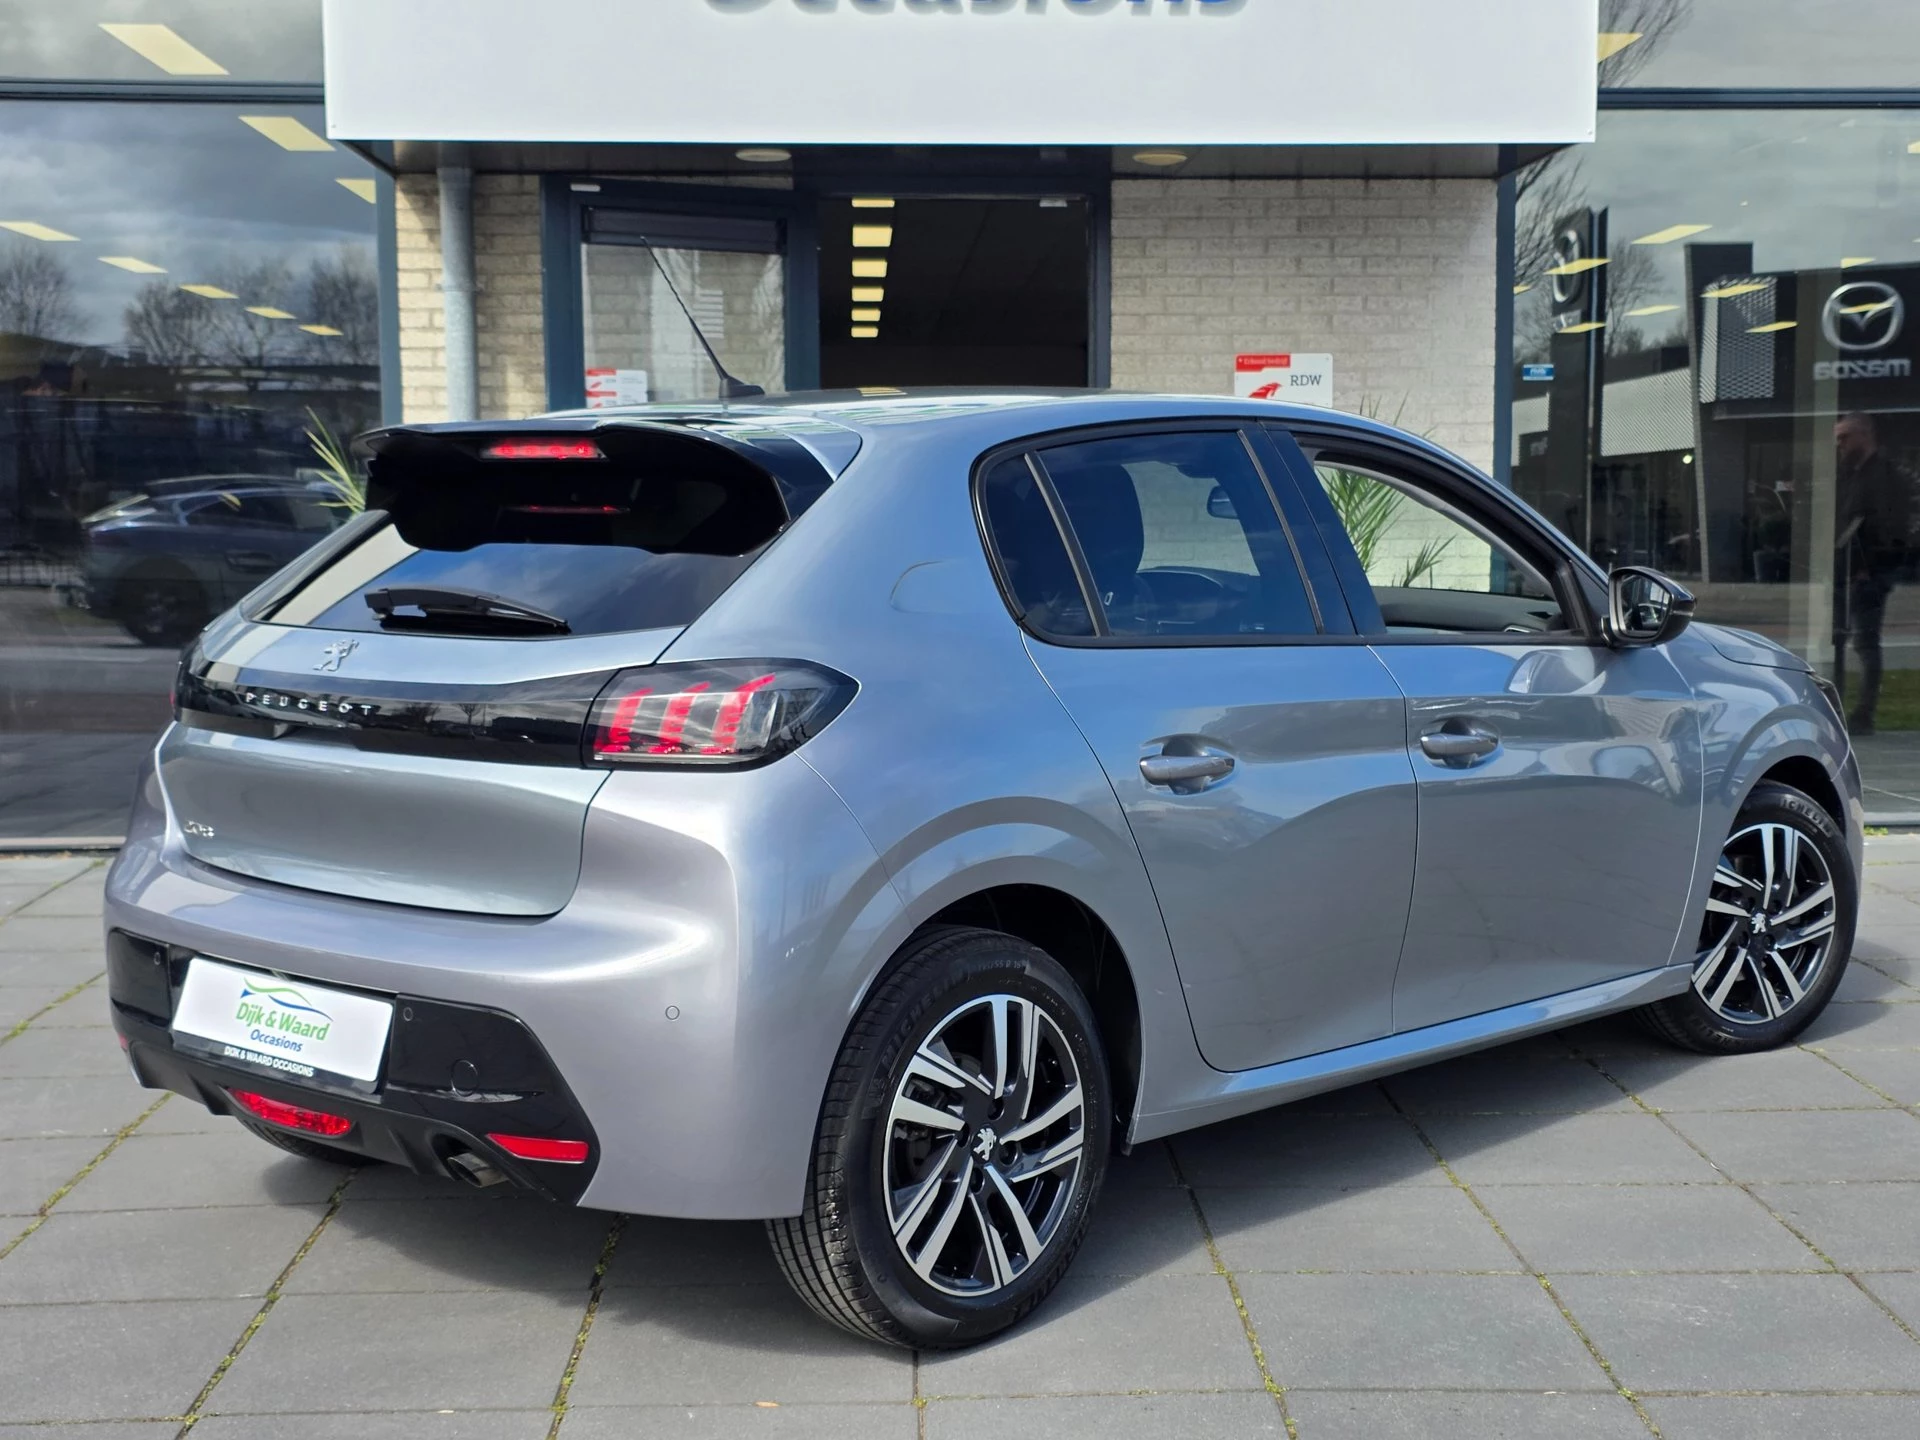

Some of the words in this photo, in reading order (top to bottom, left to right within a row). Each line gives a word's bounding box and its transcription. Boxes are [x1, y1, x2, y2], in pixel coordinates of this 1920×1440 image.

[1290, 374, 1322, 387] RDW
[245, 692, 372, 716] PEUGEOT
[236, 1002, 265, 1027] Dijk
[264, 1009, 278, 1028] &
[278, 1012, 331, 1041] Waard
[250, 1028, 304, 1052] Occasions
[246, 1050, 273, 1068] WAARD
[272, 1058, 315, 1078] OCCASIONS
